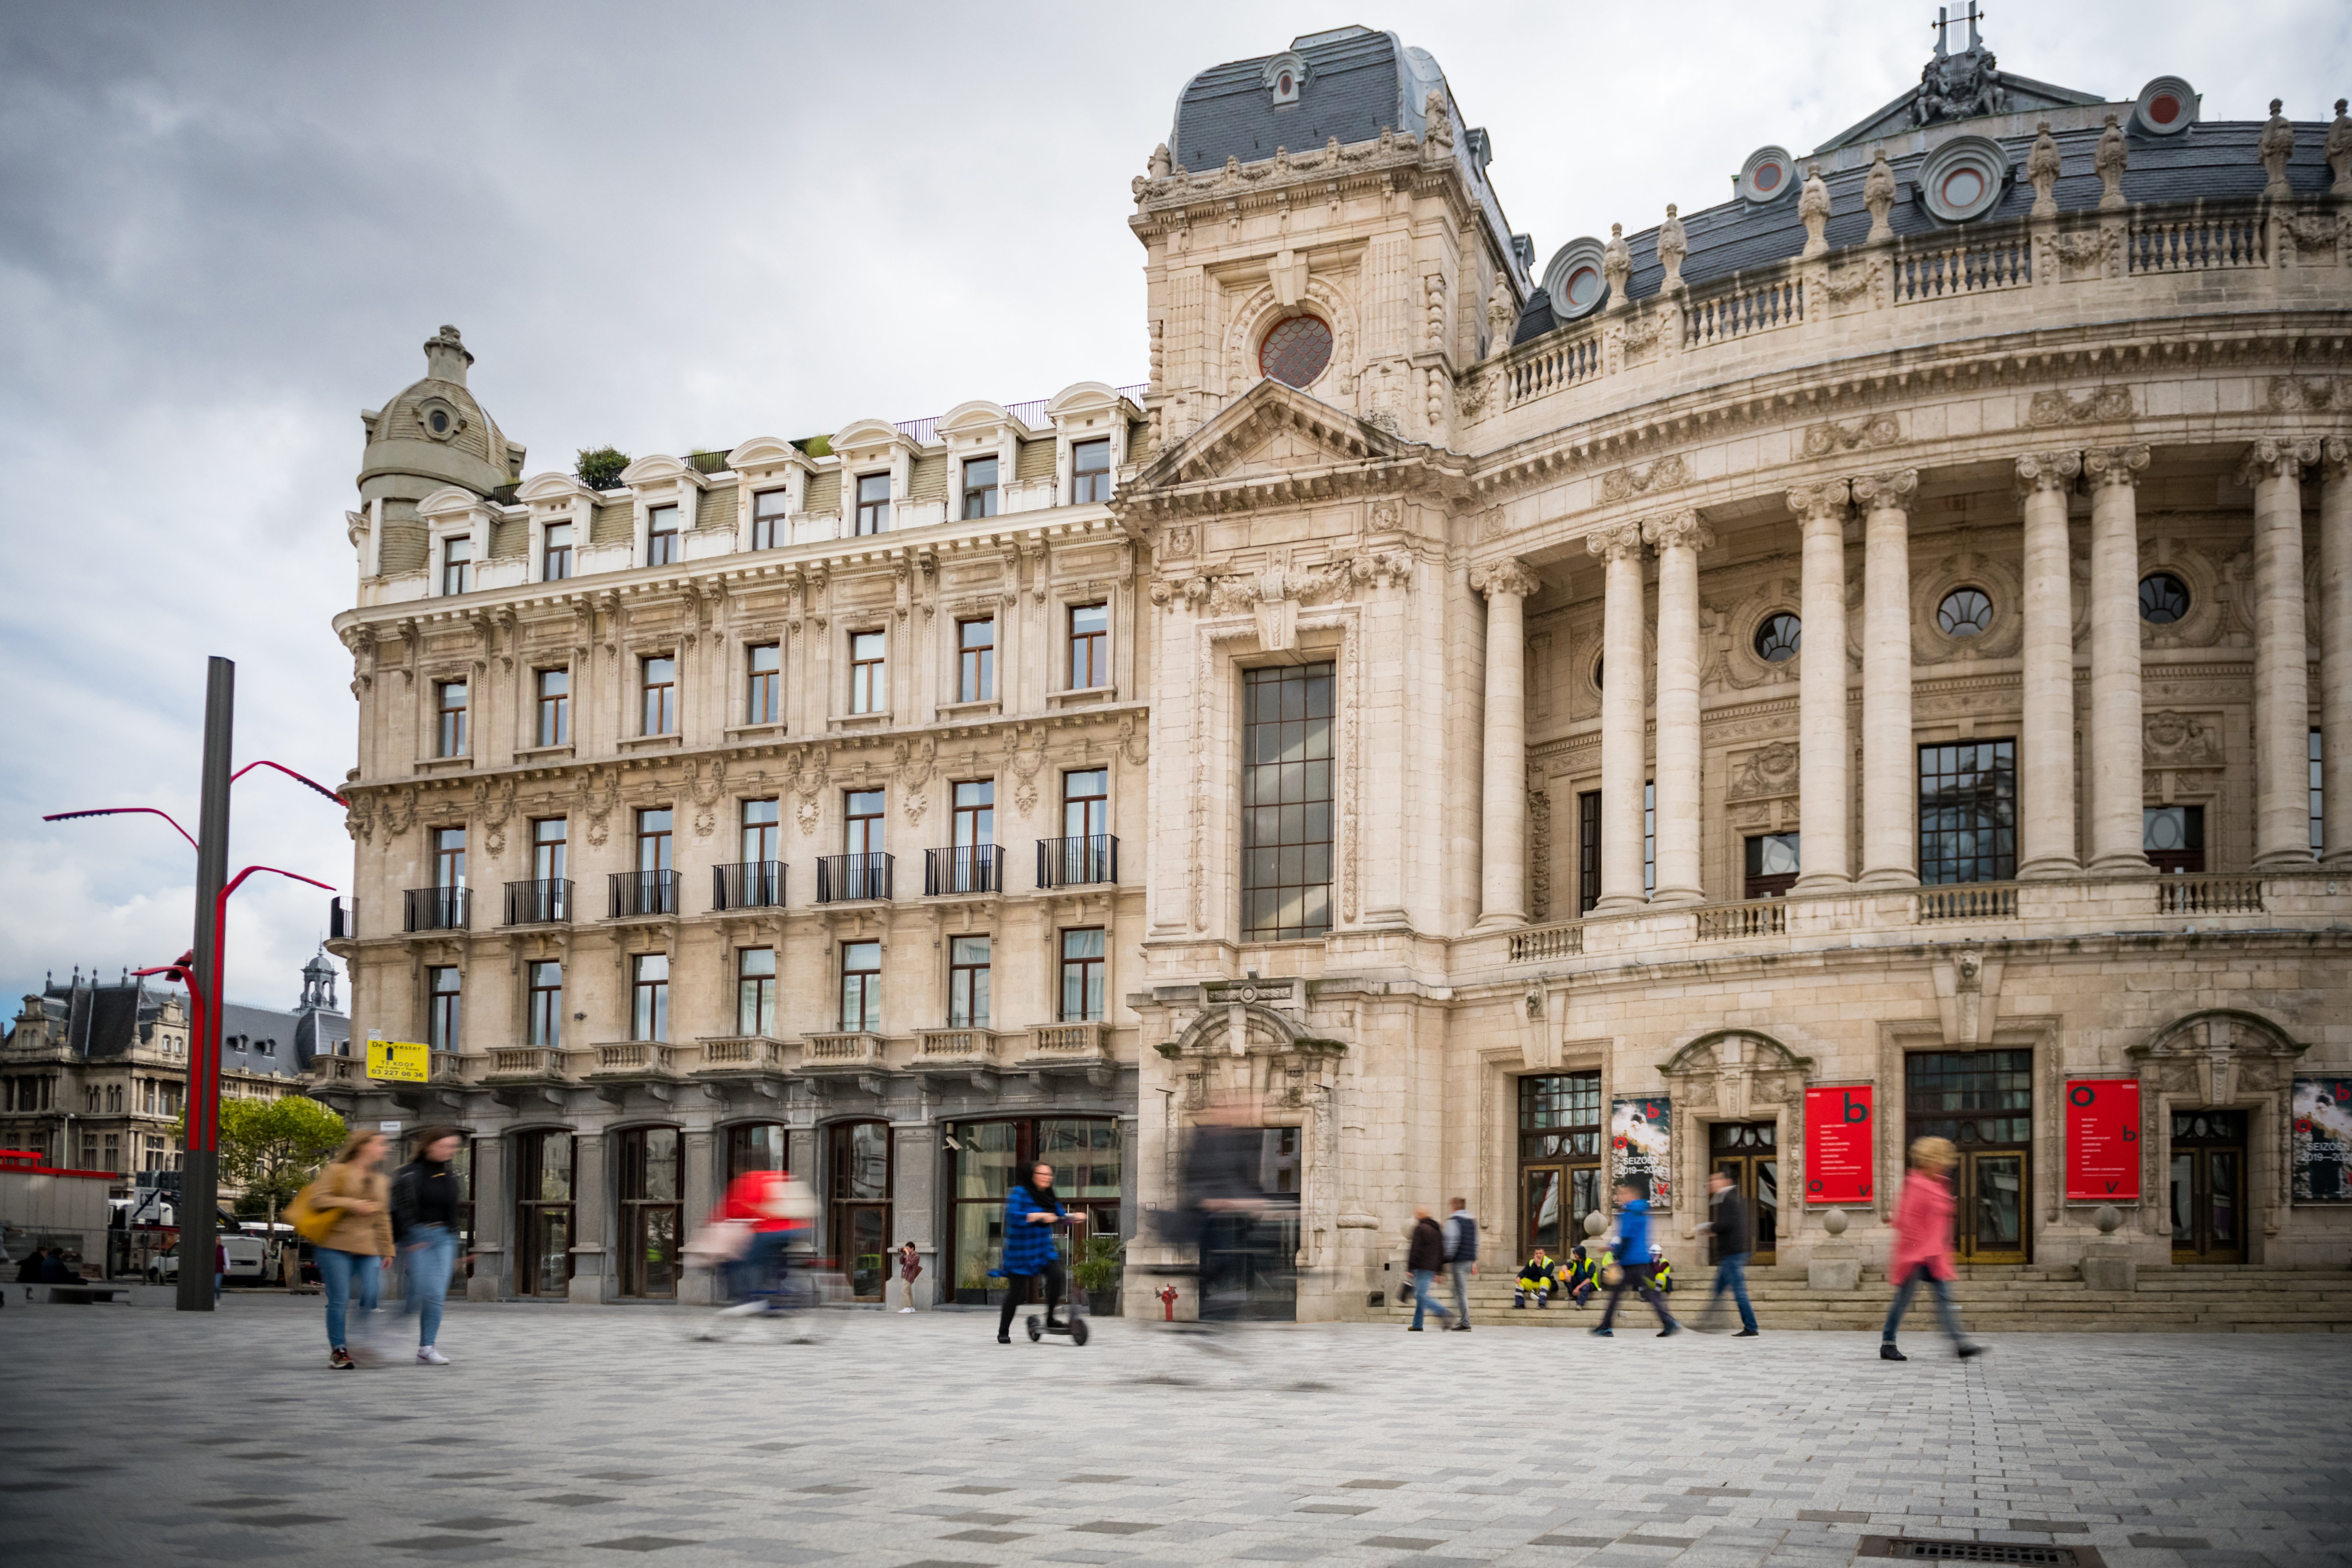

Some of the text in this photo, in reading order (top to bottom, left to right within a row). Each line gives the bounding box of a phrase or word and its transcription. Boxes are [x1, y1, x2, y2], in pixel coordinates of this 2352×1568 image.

[2336, 1083, 2350, 1100] b
[1647, 1102, 1659, 1118] b
[1844, 1092, 1868, 1123] b
[2123, 1125, 2137, 1141] b
[2307, 1143, 2349, 1151] SEIZOEN
[1623, 1157, 1659, 1165] SEIZOEN
